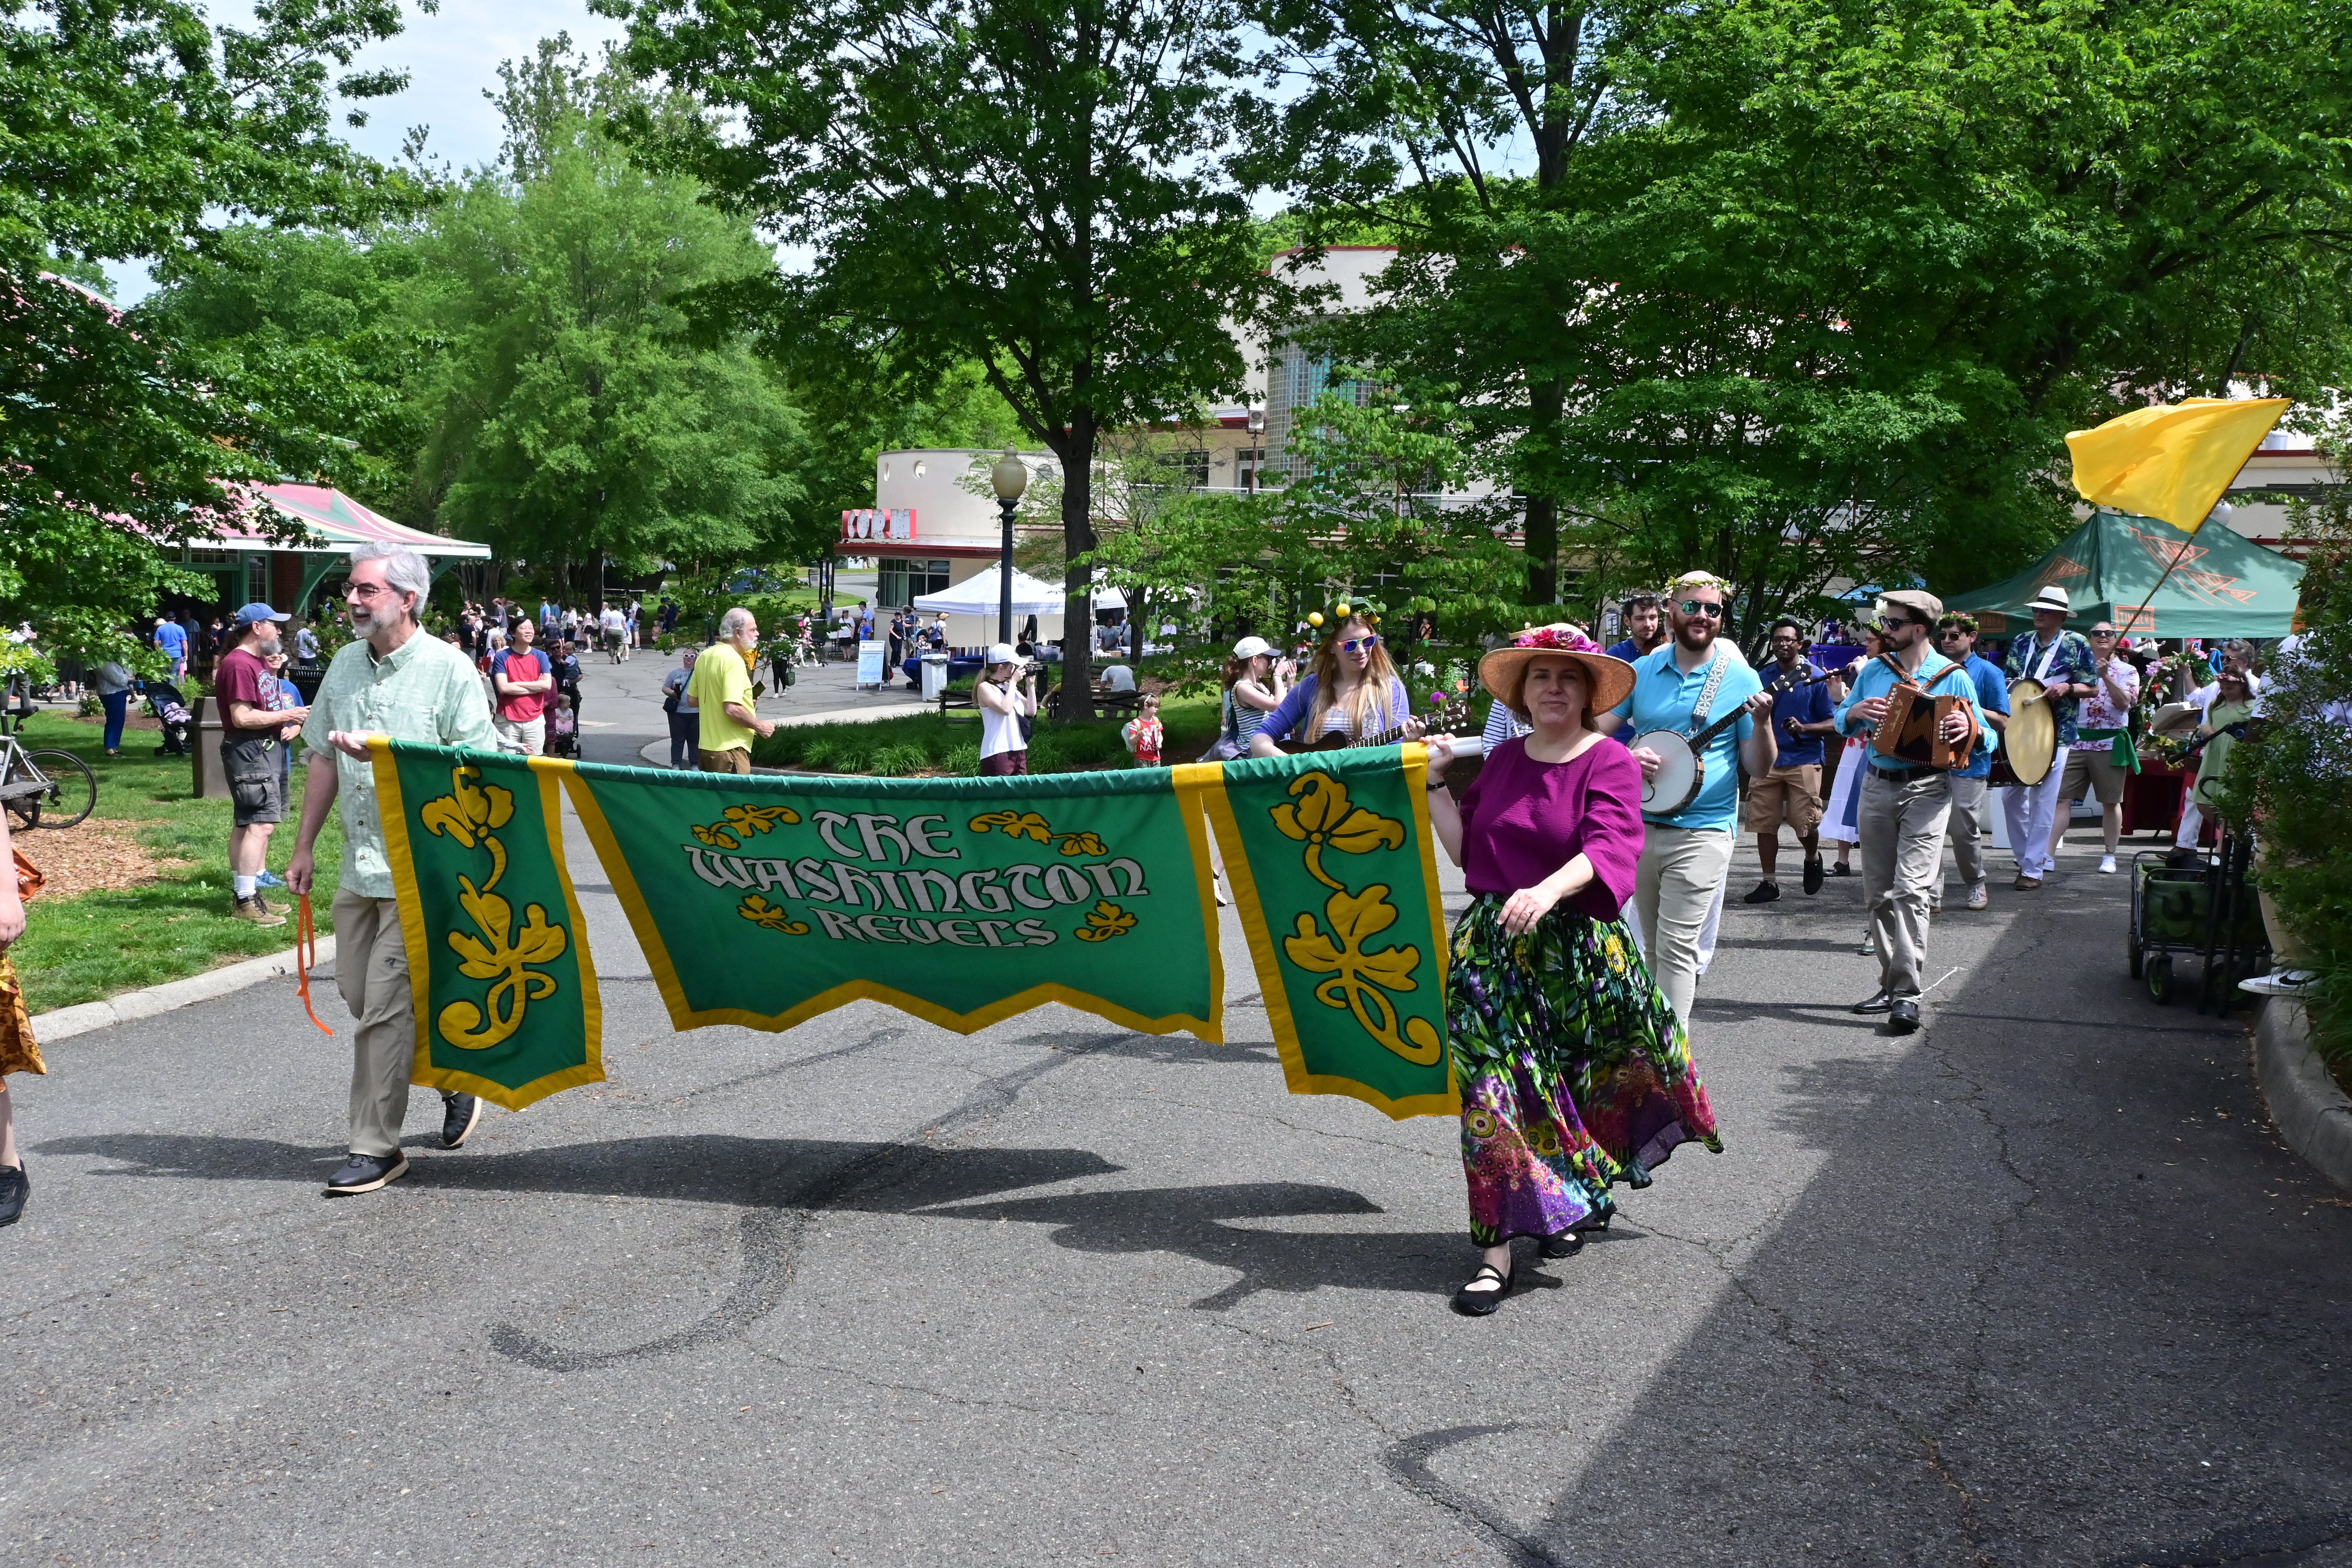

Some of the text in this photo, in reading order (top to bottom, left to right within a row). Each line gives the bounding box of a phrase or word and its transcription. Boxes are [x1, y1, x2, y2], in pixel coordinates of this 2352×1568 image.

[810, 811, 961, 866] THE
[682, 844, 1150, 914] WASHINGTON
[809, 907, 1059, 947] REVELS
